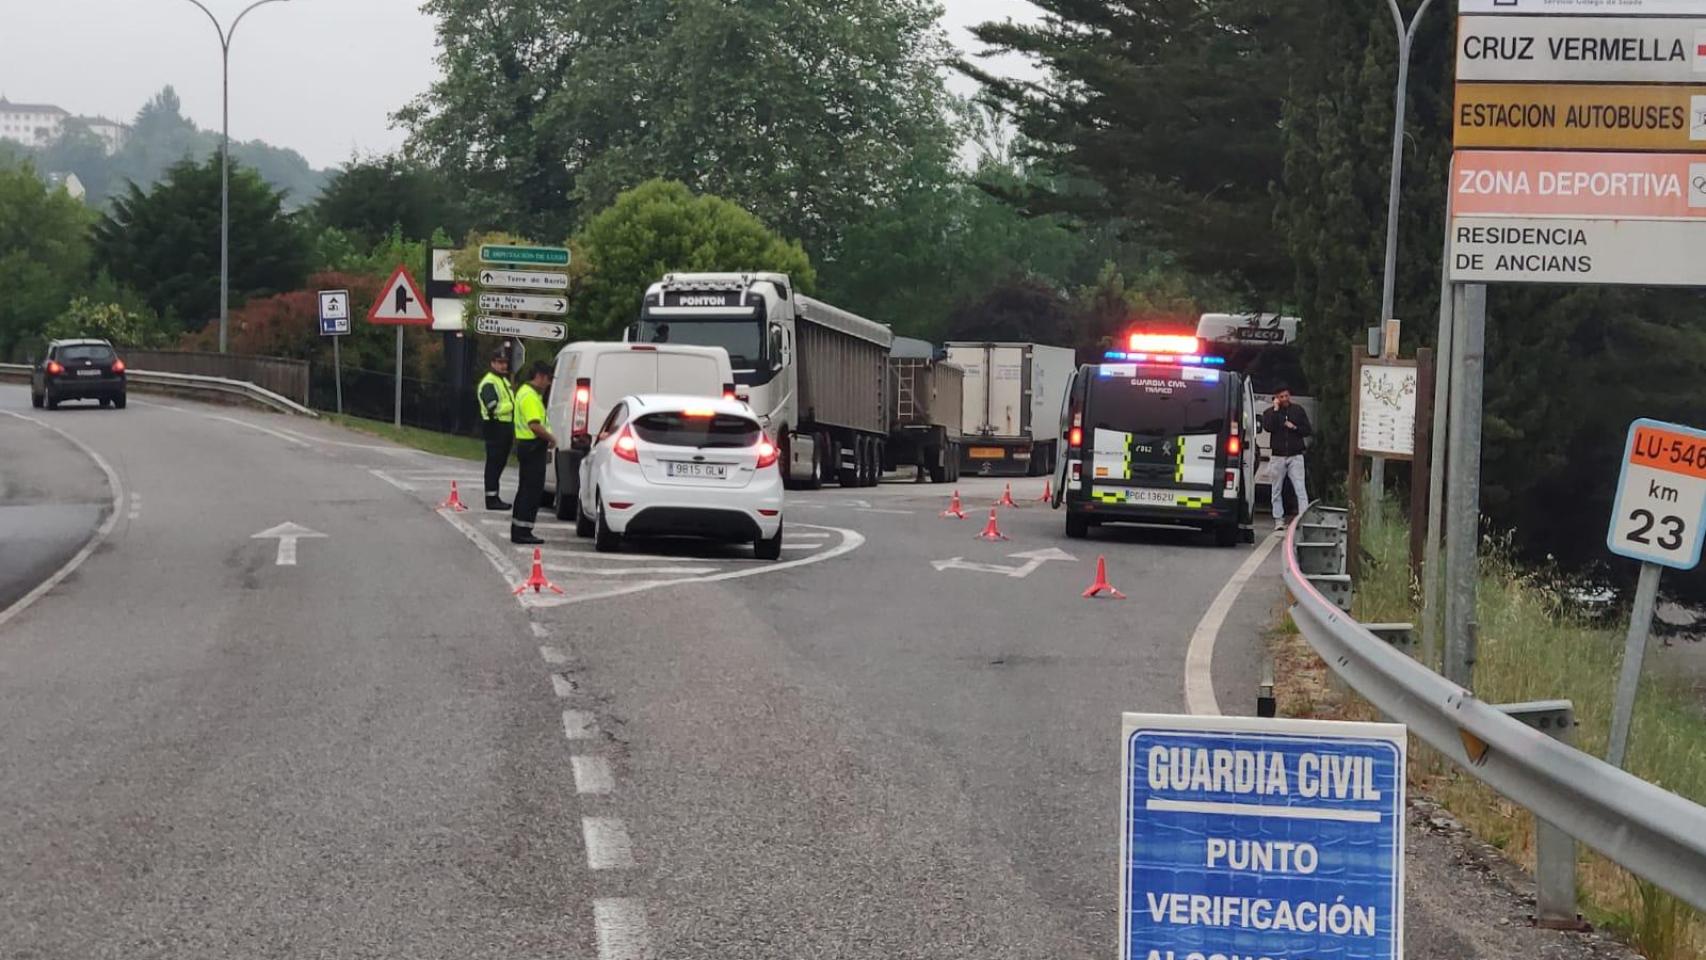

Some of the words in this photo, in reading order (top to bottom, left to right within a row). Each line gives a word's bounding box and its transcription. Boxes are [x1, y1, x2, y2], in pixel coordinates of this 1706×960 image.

[1463, 36, 1534, 60] CRUZ
[1547, 37, 1686, 61] VERMELLA
[1460, 103, 1555, 128] ESTACION
[1565, 104, 1684, 129] AUTOBUSES
[1458, 169, 1530, 194] ZONA
[1538, 171, 1681, 197] DEPORTIVA
[1456, 227, 1587, 246] RESIDENCIA
[1455, 254, 1483, 270] DE
[1495, 255, 1592, 273] ANCIANS
[481, 294, 500, 302] Casa
[679, 296, 725, 306] PONTON
[1131, 379, 1166, 388] GUARDIA
[1168, 380, 1187, 389] CIVIL
[1634, 432, 1706, 470] LU-546
[676, 463, 701, 475] 9815
[1648, 479, 1678, 502] km
[1626, 508, 1685, 550] 23
[1147, 745, 1288, 796] GUARDIA
[1298, 752, 1381, 801] CIVIL
[1206, 838, 1318, 874] PUNTO
[1147, 891, 1375, 937] VERIFICACIÓN
